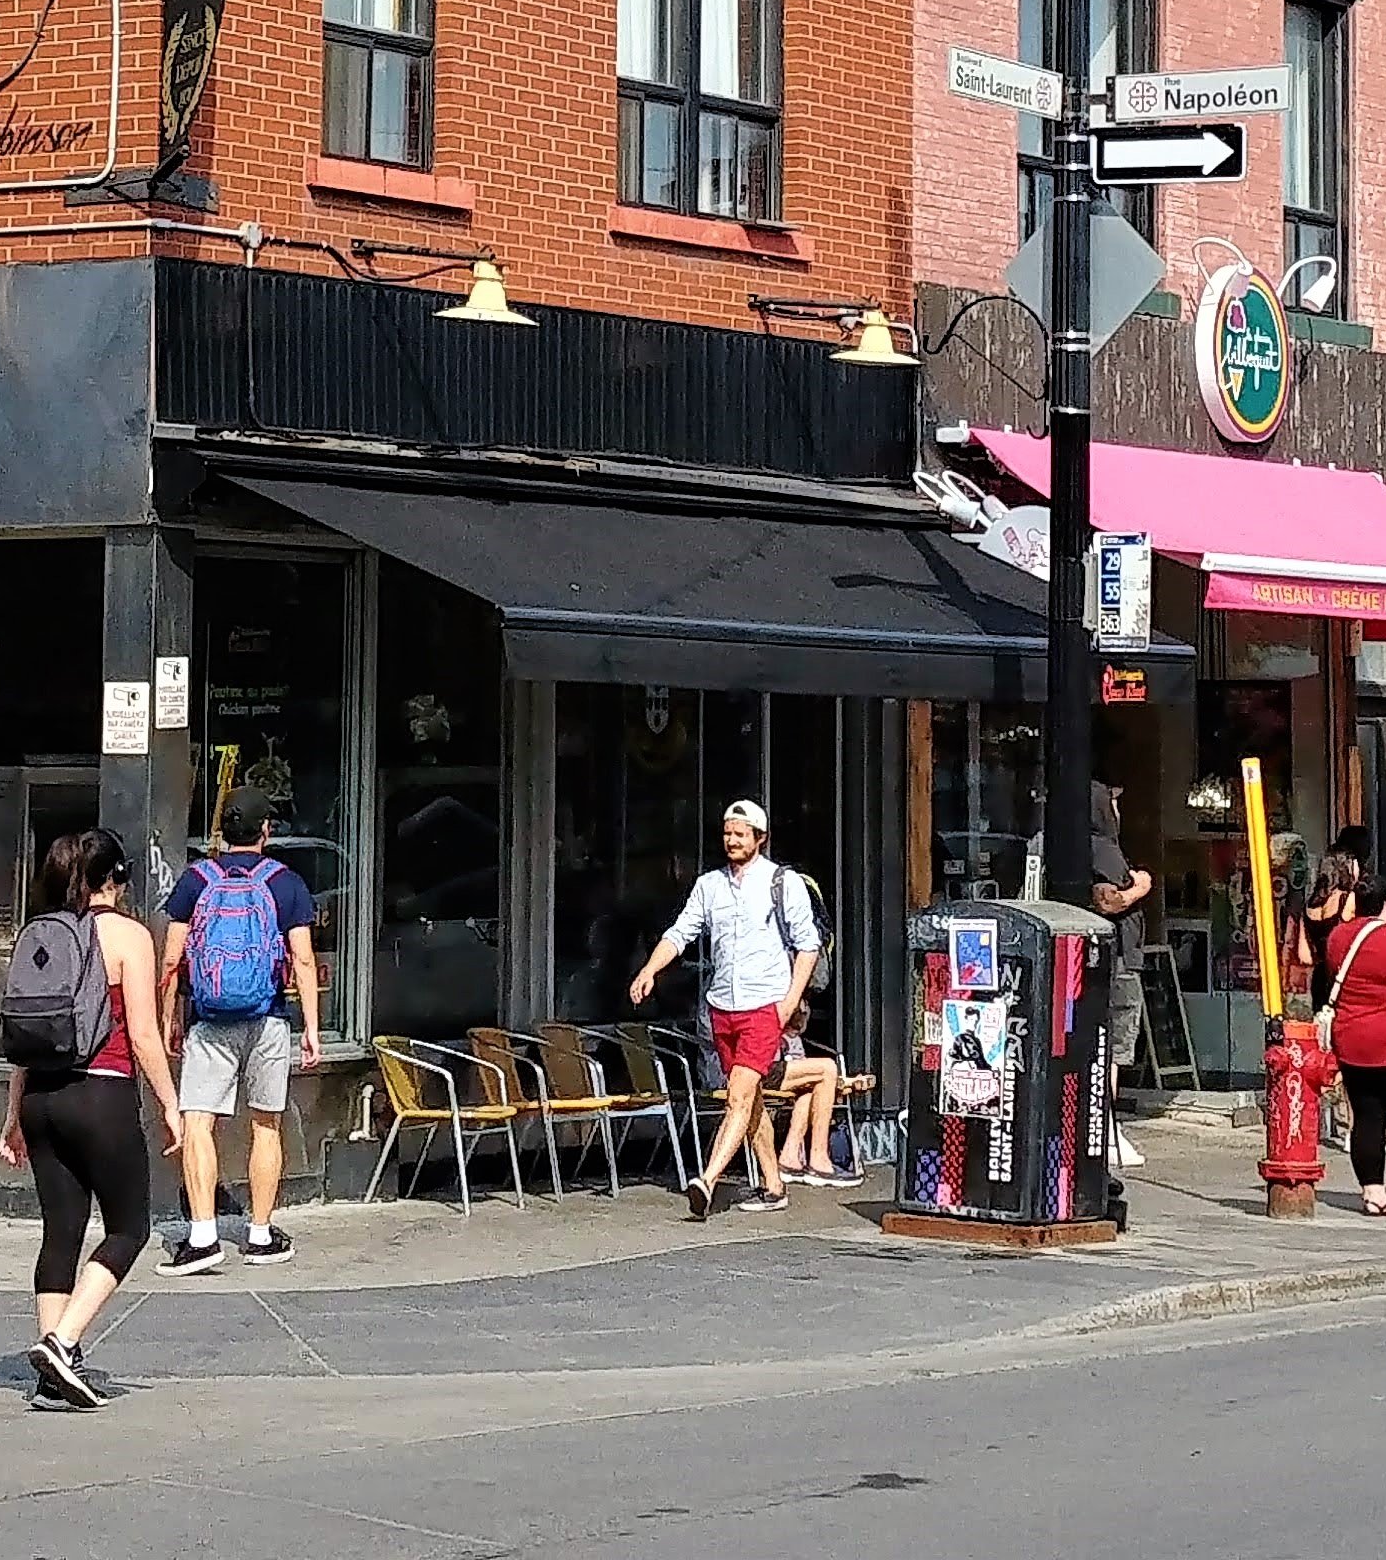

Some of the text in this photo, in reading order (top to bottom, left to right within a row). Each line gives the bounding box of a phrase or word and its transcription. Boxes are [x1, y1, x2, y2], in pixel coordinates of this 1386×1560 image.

[955, 65, 1033, 106] Saint-Laurent
[1164, 77, 1181, 86] Rue
[1164, 83, 1278, 114] Napoléon
[1105, 552, 1121, 572] 29
[1104, 581, 1121, 601] 55
[1252, 583, 1314, 606] ARTISAN
[1331, 585, 1382, 611] CRÈME
[1100, 614, 1121, 634] 363
[988, 1117, 1002, 1181] BOULEV
